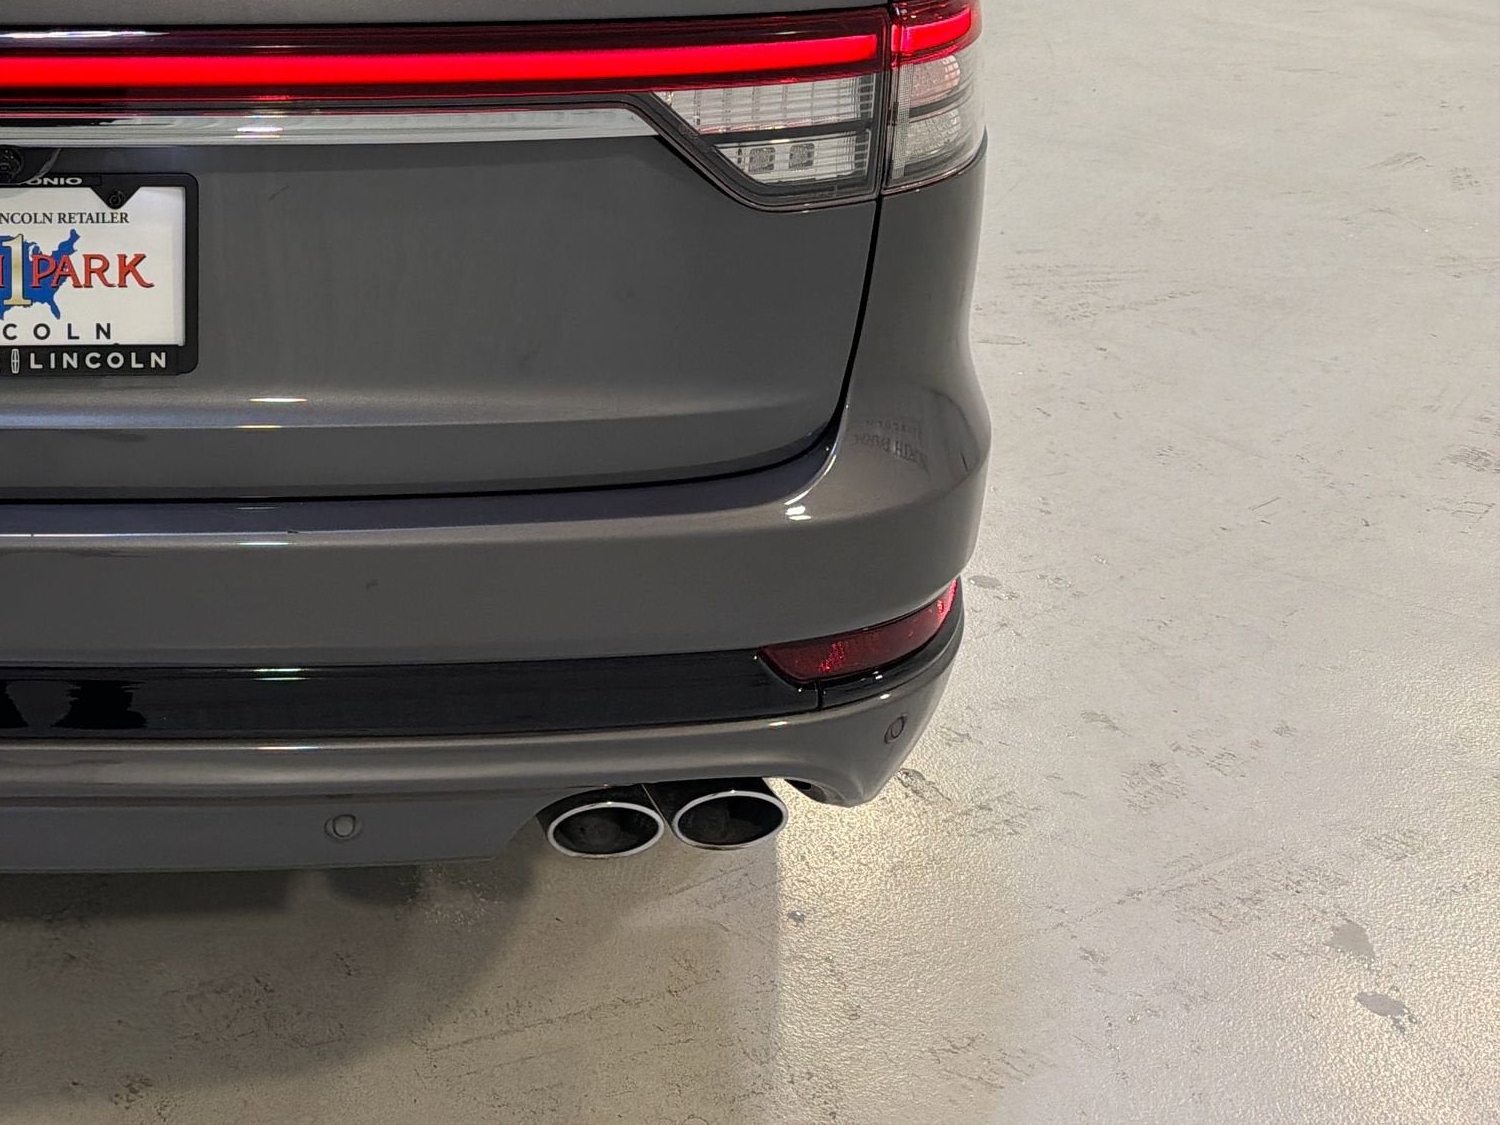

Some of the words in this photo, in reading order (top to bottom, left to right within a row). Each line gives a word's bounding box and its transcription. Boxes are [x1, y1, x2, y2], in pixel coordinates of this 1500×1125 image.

[57, 212, 129, 224] RETAILER
[31, 253, 155, 288] PARK
[30, 351, 167, 370] LINCOLN
